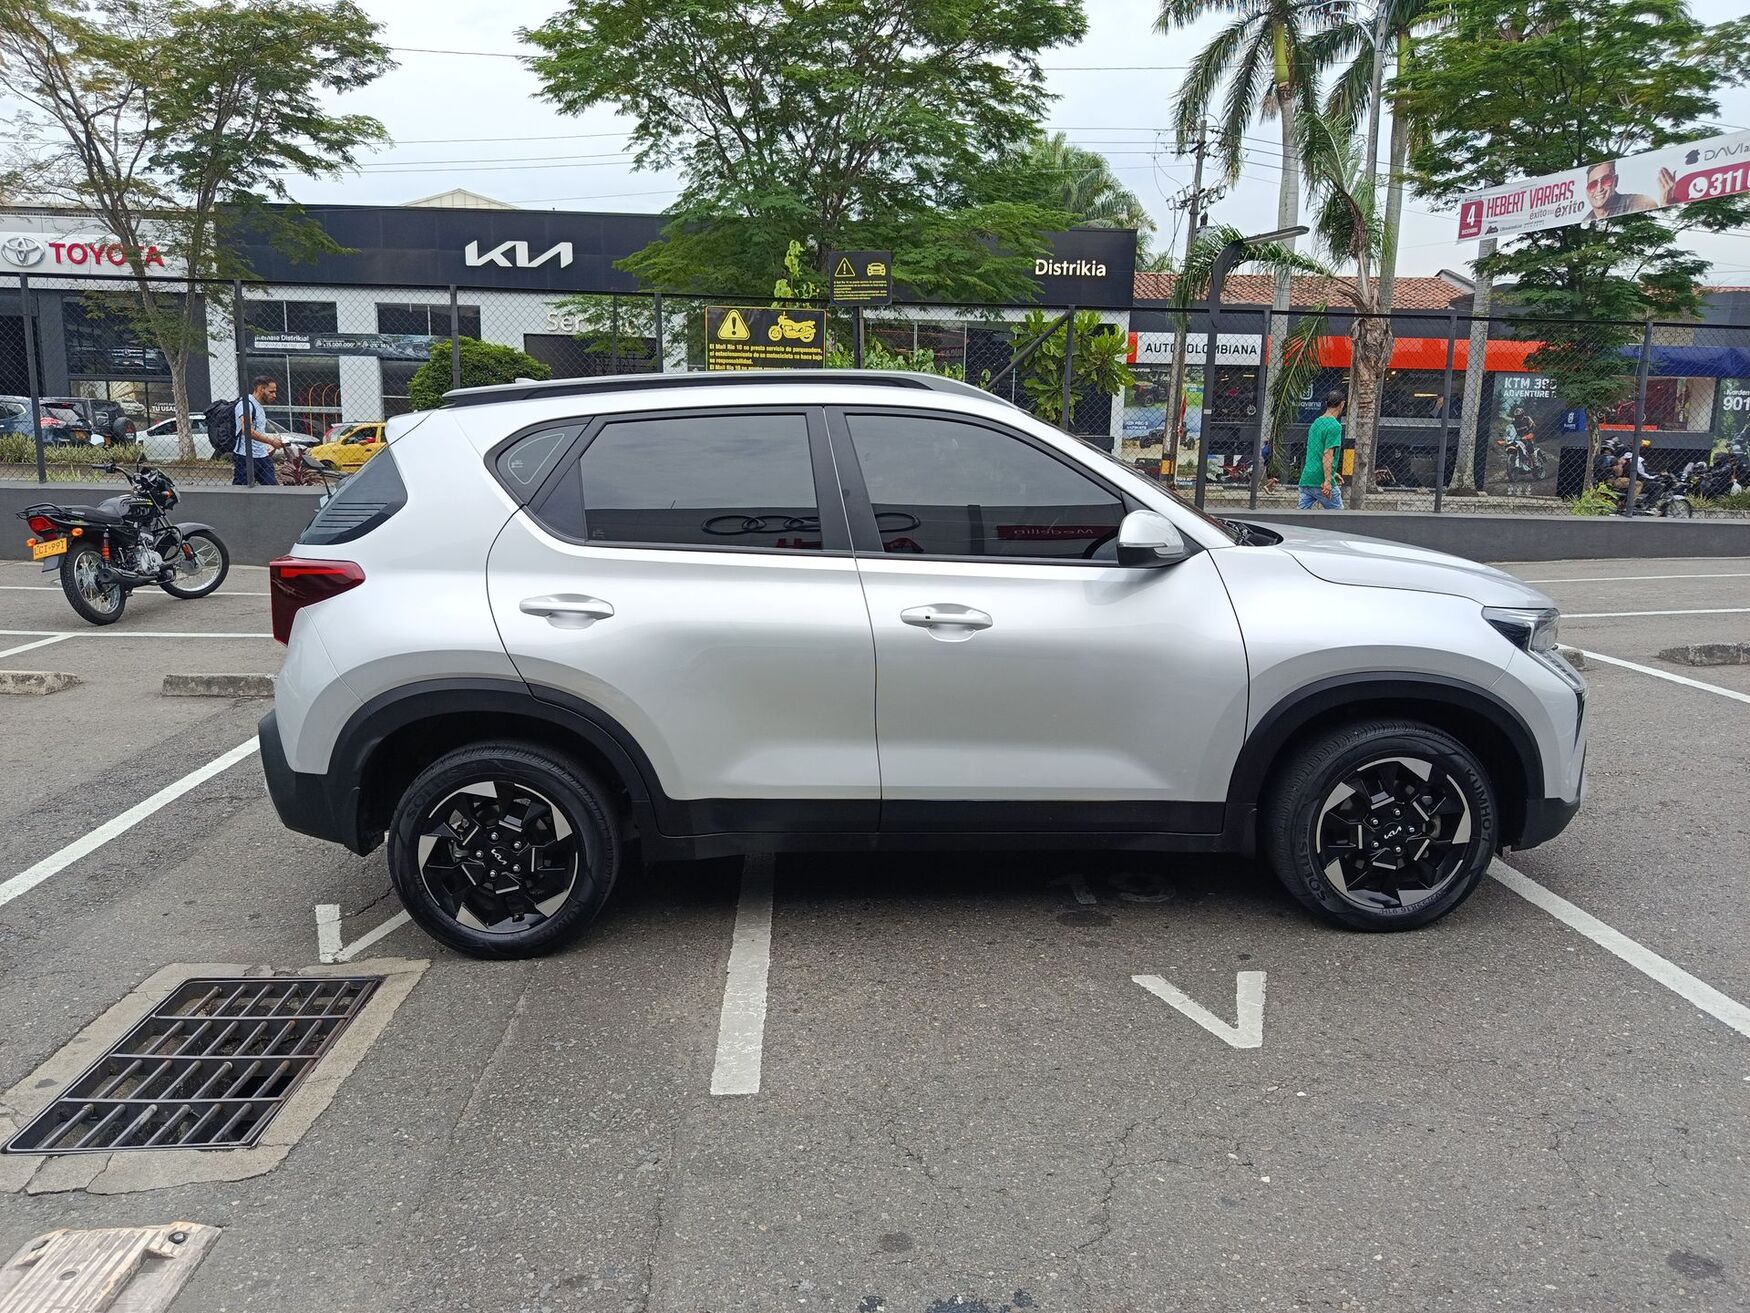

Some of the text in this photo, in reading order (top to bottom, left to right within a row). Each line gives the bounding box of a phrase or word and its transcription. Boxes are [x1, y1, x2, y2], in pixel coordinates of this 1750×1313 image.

[1709, 168, 1744, 196] 311
[1486, 180, 1575, 218] HEBERT VARGAS
[1466, 205, 1476, 226] 4
[1554, 201, 1585, 218] éxito
[48, 242, 165, 267] TOYOA
[1035, 259, 1106, 276] Distrikia
[1145, 343, 1258, 355] AUTOOLOBIANA
[1504, 377, 1531, 389] KTM
[1503, 389, 1550, 398] ADVENTURE
[1723, 396, 1750, 411] 901
